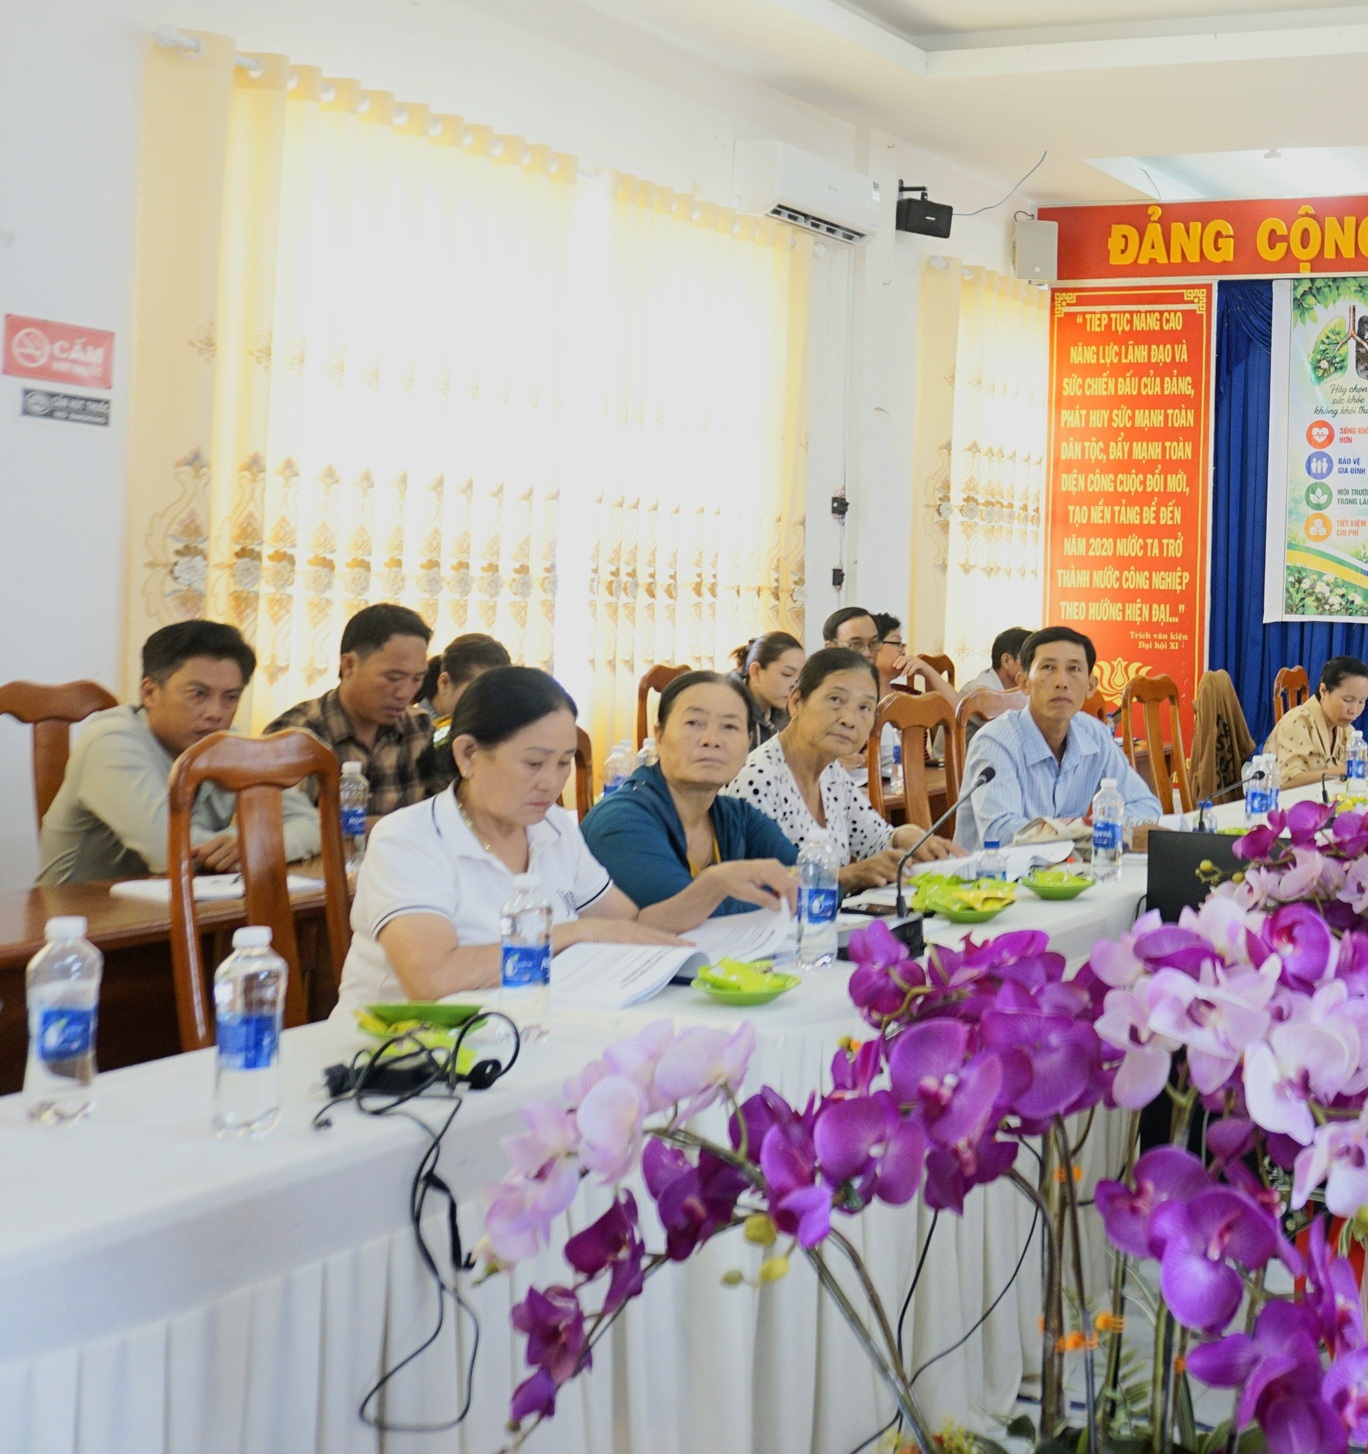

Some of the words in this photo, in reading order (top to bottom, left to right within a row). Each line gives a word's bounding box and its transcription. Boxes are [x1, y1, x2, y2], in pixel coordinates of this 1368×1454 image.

[1107, 204, 1234, 265] ĐẢNG
[1110, 313, 1130, 335] TỤC
[1162, 312, 1183, 330] CAO
[1070, 343, 1097, 364] NĂNG
[1099, 342, 1119, 367] LỰC
[1121, 341, 1148, 363] LÃNH
[1150, 344, 1172, 366] ĐẠO
[1175, 339, 1188, 362] VÀ
[1062, 373, 1083, 396] SỨC
[1084, 370, 1115, 396] CHIẾN
[1117, 370, 1138, 395] ĐẤU
[1140, 370, 1161, 395] CỦA
[1163, 369, 1194, 398] ĐẢNG,
[1060, 405, 1087, 428] PHÁT
[1089, 408, 1110, 428] HUY
[1111, 404, 1132, 428] SỨC
[1134, 408, 1164, 431] MẠNH
[1166, 404, 1194, 428] TOÀN
[1060, 437, 1082, 460] DÂN
[1083, 437, 1107, 463] TỘC,
[1109, 432, 1130, 460] ĐẨY
[1132, 441, 1162, 464] MẠNH
[1164, 436, 1192, 460] TOÀN
[1061, 468, 1085, 496] DIỆN
[1087, 469, 1115, 492] CÔNG
[1116, 469, 1143, 496] CUỘC
[1146, 464, 1164, 492] ĐỔI
[1167, 468, 1190, 496] MỚI,
[1068, 505, 1088, 527] TẠO
[1090, 499, 1111, 524] NỀN
[1114, 499, 1140, 525] TẢNG
[1143, 497, 1158, 525] ĐỂ
[1160, 499, 1181, 525] ĐẾN
[1063, 534, 1086, 556] NĂM
[1088, 537, 1114, 557] 2020
[1116, 534, 1144, 557] NƯỚC
[1146, 538, 1159, 557] TA
[1162, 532, 1183, 558] TRỞ
[1057, 565, 1090, 588] THÀNH
[1092, 565, 1120, 589] NƯỚC
[1122, 566, 1150, 590] CÔNG
[1152, 567, 1190, 594] NGHIỆP
[1060, 601, 1086, 620] THEO
[1089, 597, 1123, 621] HƯỚNG
[1125, 599, 1149, 626] HIỆN
[1129, 631, 1151, 640] Trích
[1153, 632, 1168, 640] văn
[1170, 631, 1188, 642] kiện
[1138, 641, 1152, 650] Đại
[1154, 641, 1168, 650] hội
